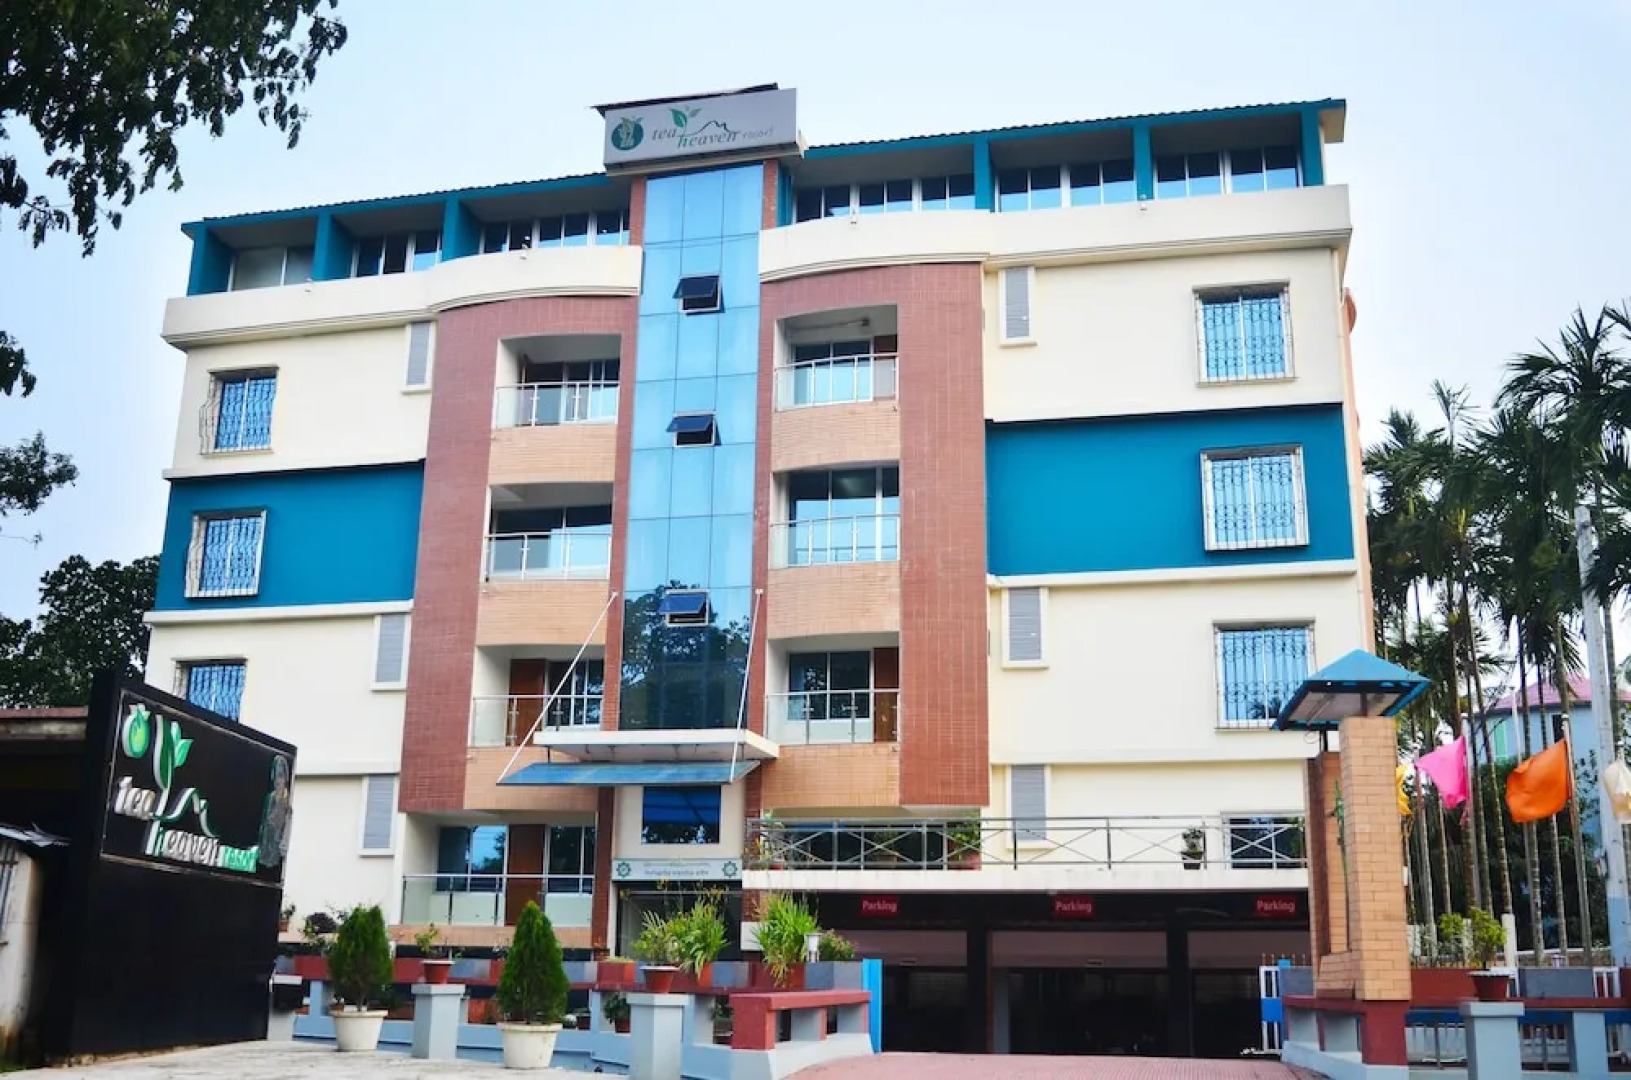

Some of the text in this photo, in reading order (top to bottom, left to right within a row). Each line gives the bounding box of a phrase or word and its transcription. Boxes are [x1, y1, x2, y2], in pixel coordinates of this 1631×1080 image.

[652, 128, 677, 140] tea
[677, 130, 738, 148] heaven
[114, 776, 157, 820] tea
[145, 818, 219, 867] heaven
[862, 900, 898, 913] Parking
[1055, 900, 1092, 913] Parking
[1257, 900, 1296, 912] Parking
